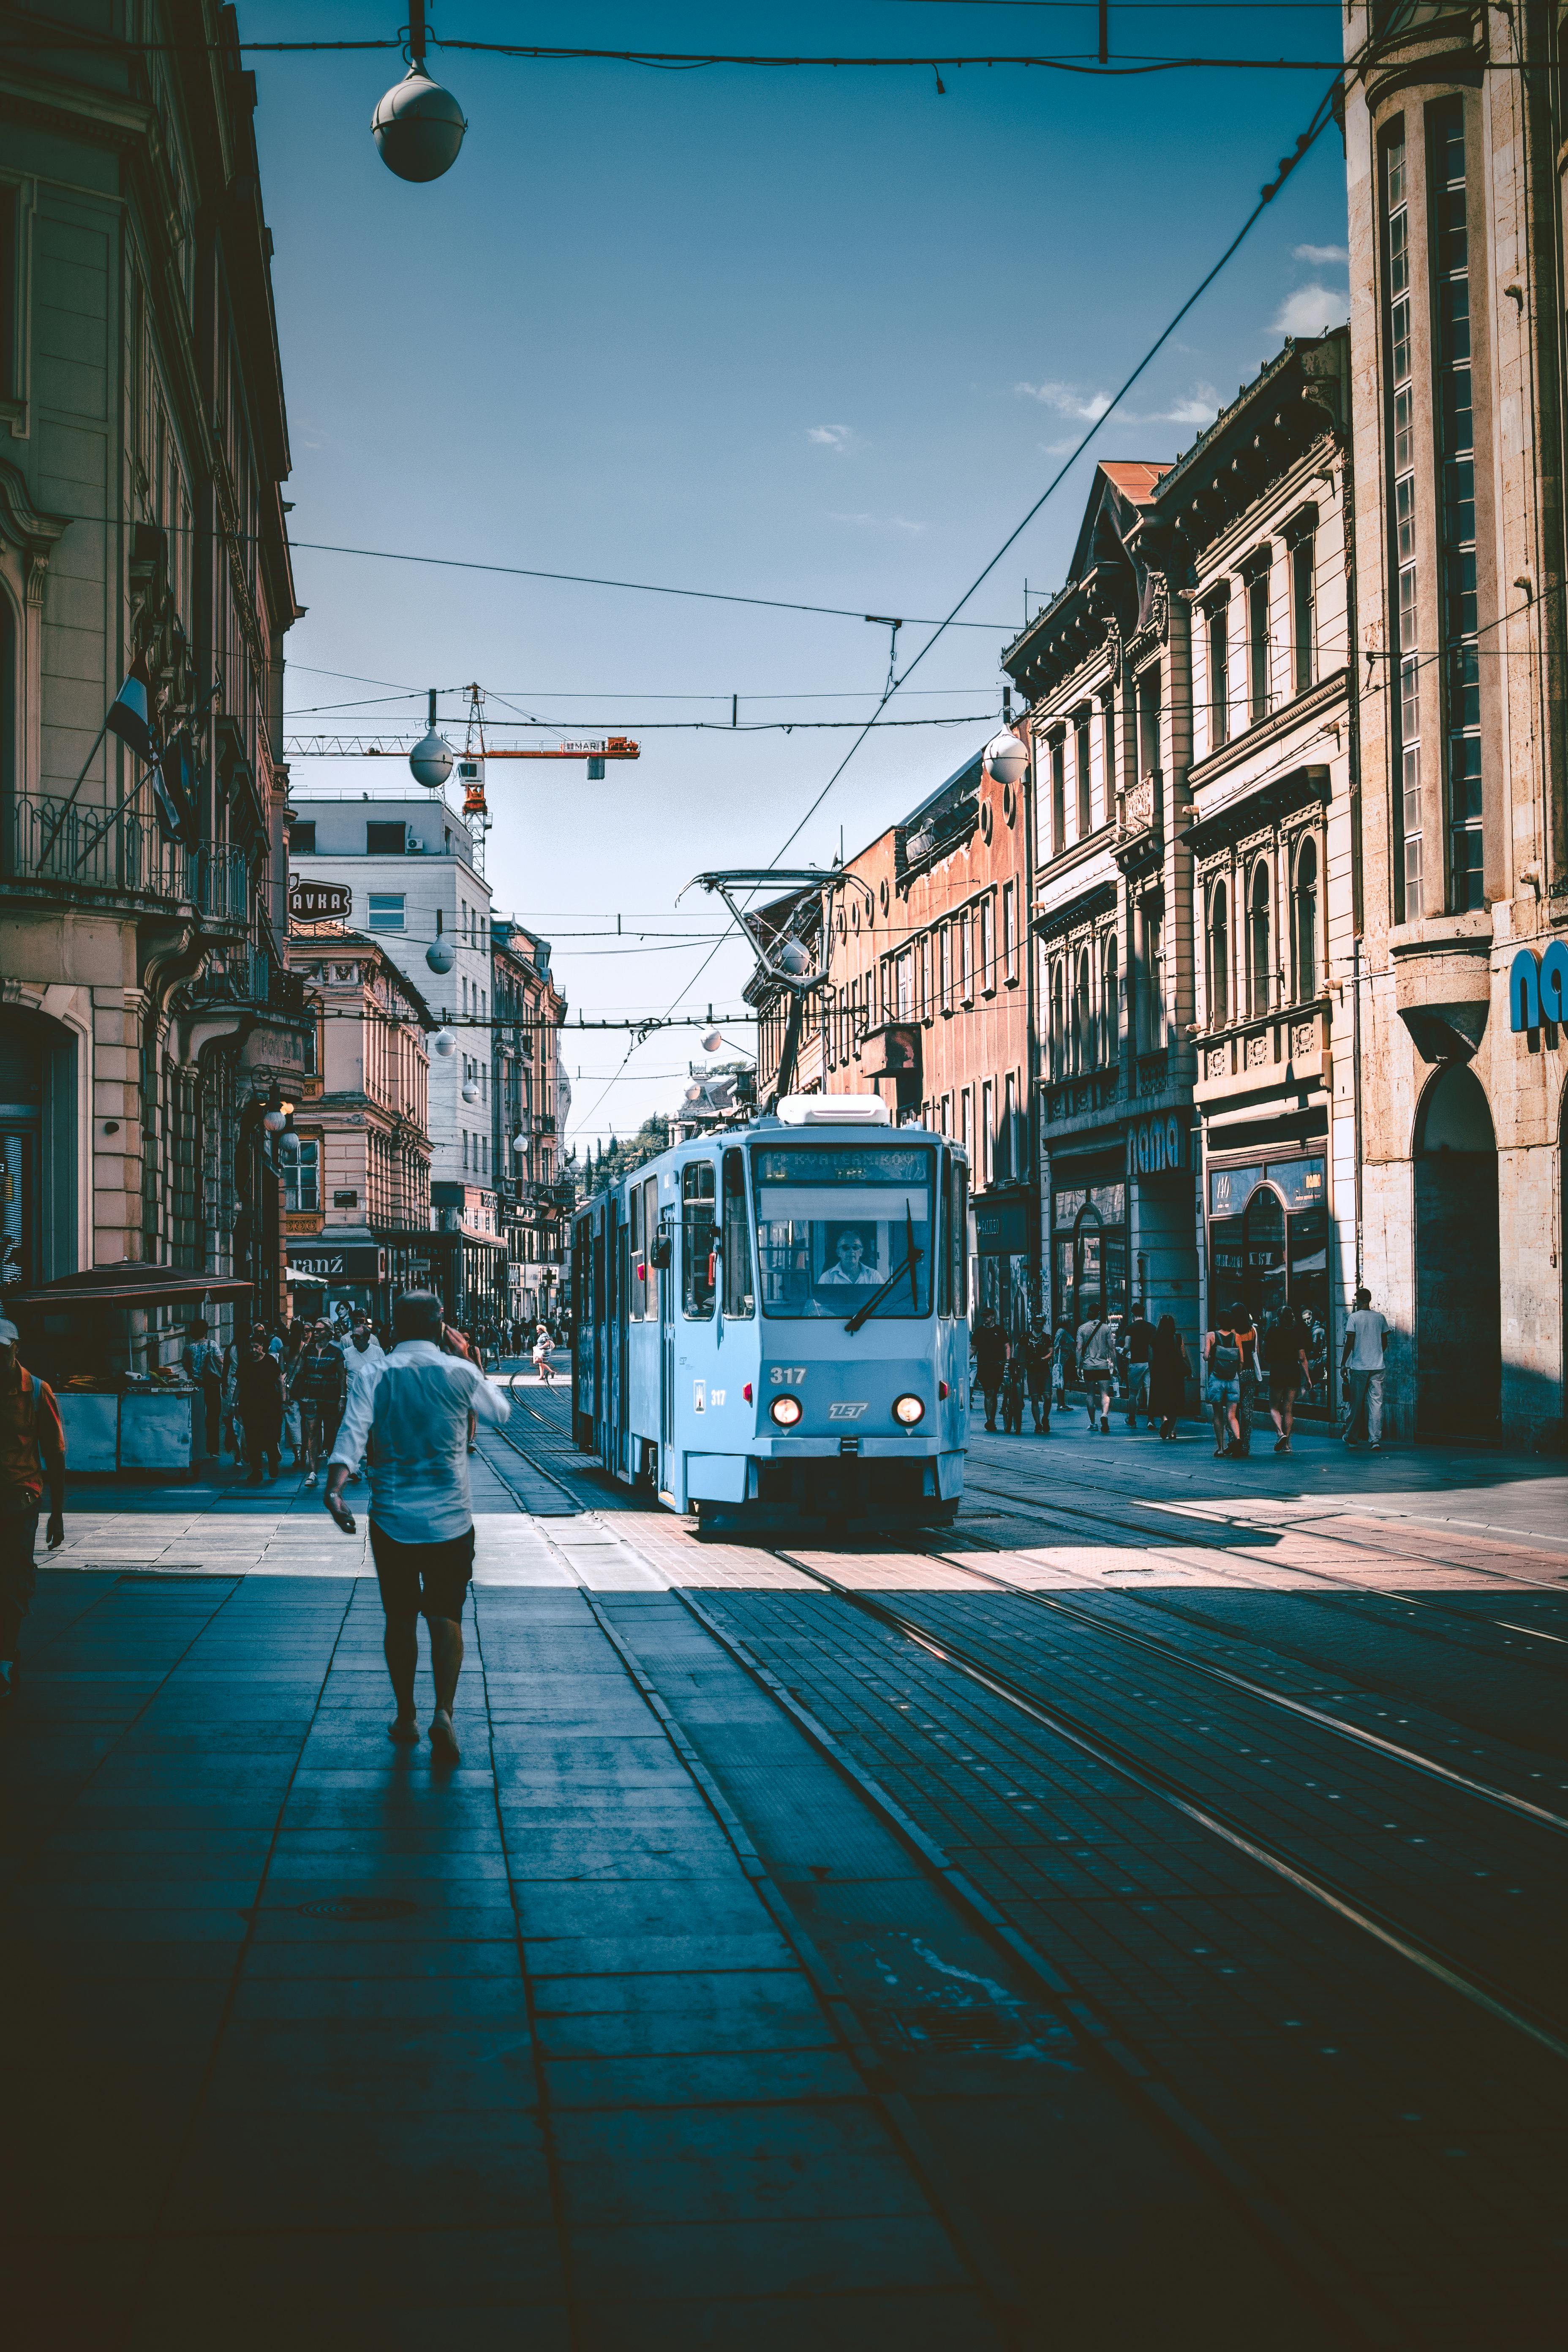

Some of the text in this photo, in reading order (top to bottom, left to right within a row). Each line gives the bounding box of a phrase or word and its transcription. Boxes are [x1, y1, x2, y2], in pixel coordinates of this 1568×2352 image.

[1127, 1113, 1178, 1175] nama
[1306, 1174, 1321, 1188] nama
[770, 1367, 806, 1384] 317
[711, 1390, 725, 1406] 317
[829, 1403, 868, 1418] ZET
